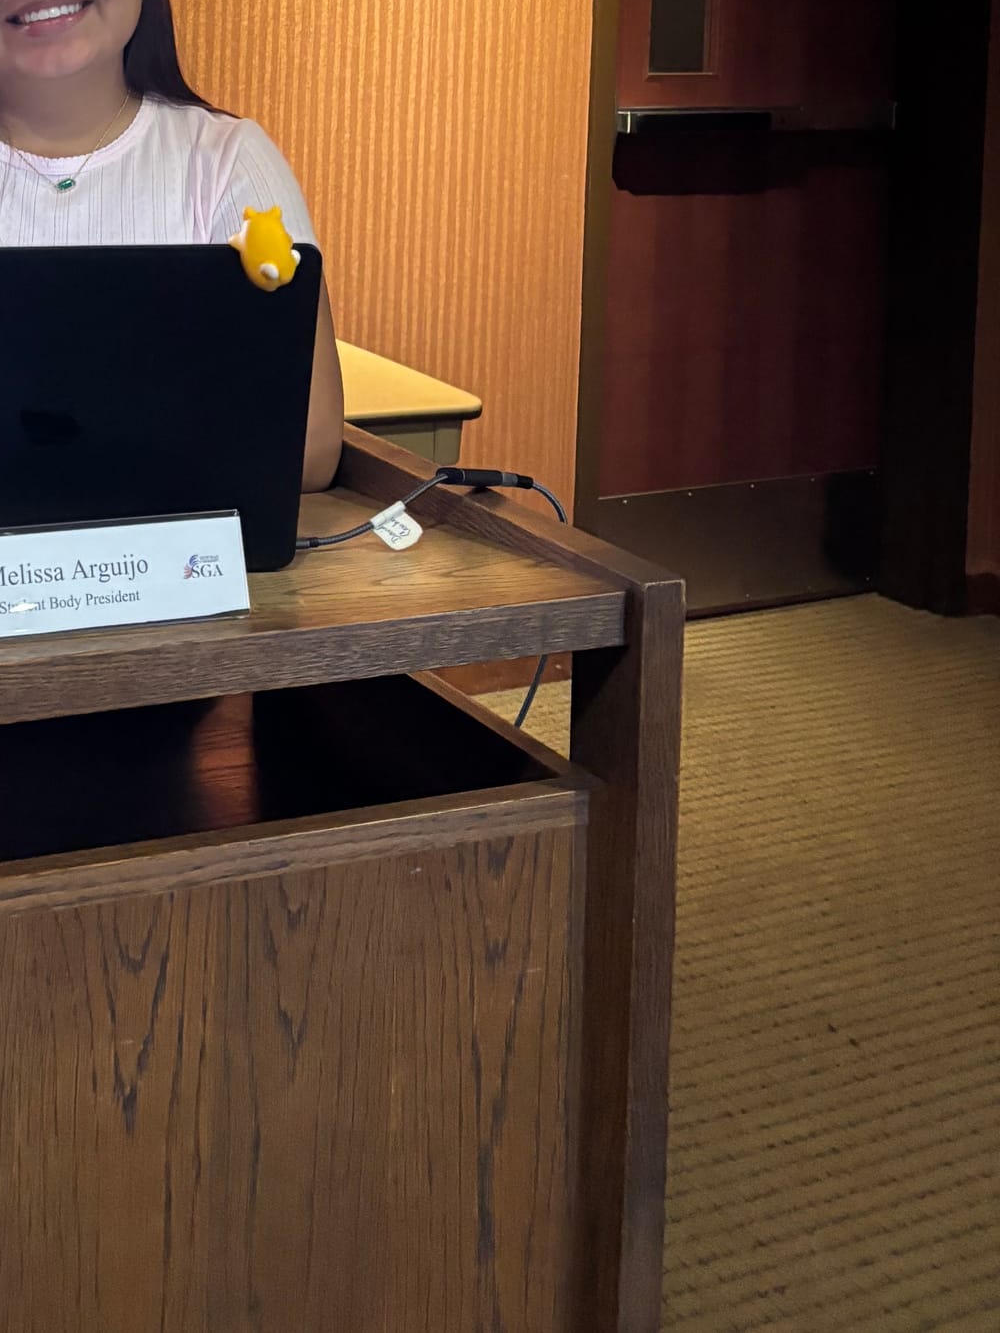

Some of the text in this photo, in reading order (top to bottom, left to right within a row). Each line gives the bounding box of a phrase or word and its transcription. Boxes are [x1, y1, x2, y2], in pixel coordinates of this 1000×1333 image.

[72, 554, 149, 583] Arguijo
[191, 564, 223, 578] SGA
[49, 593, 82, 610] Body
[85, 590, 140, 606] President
